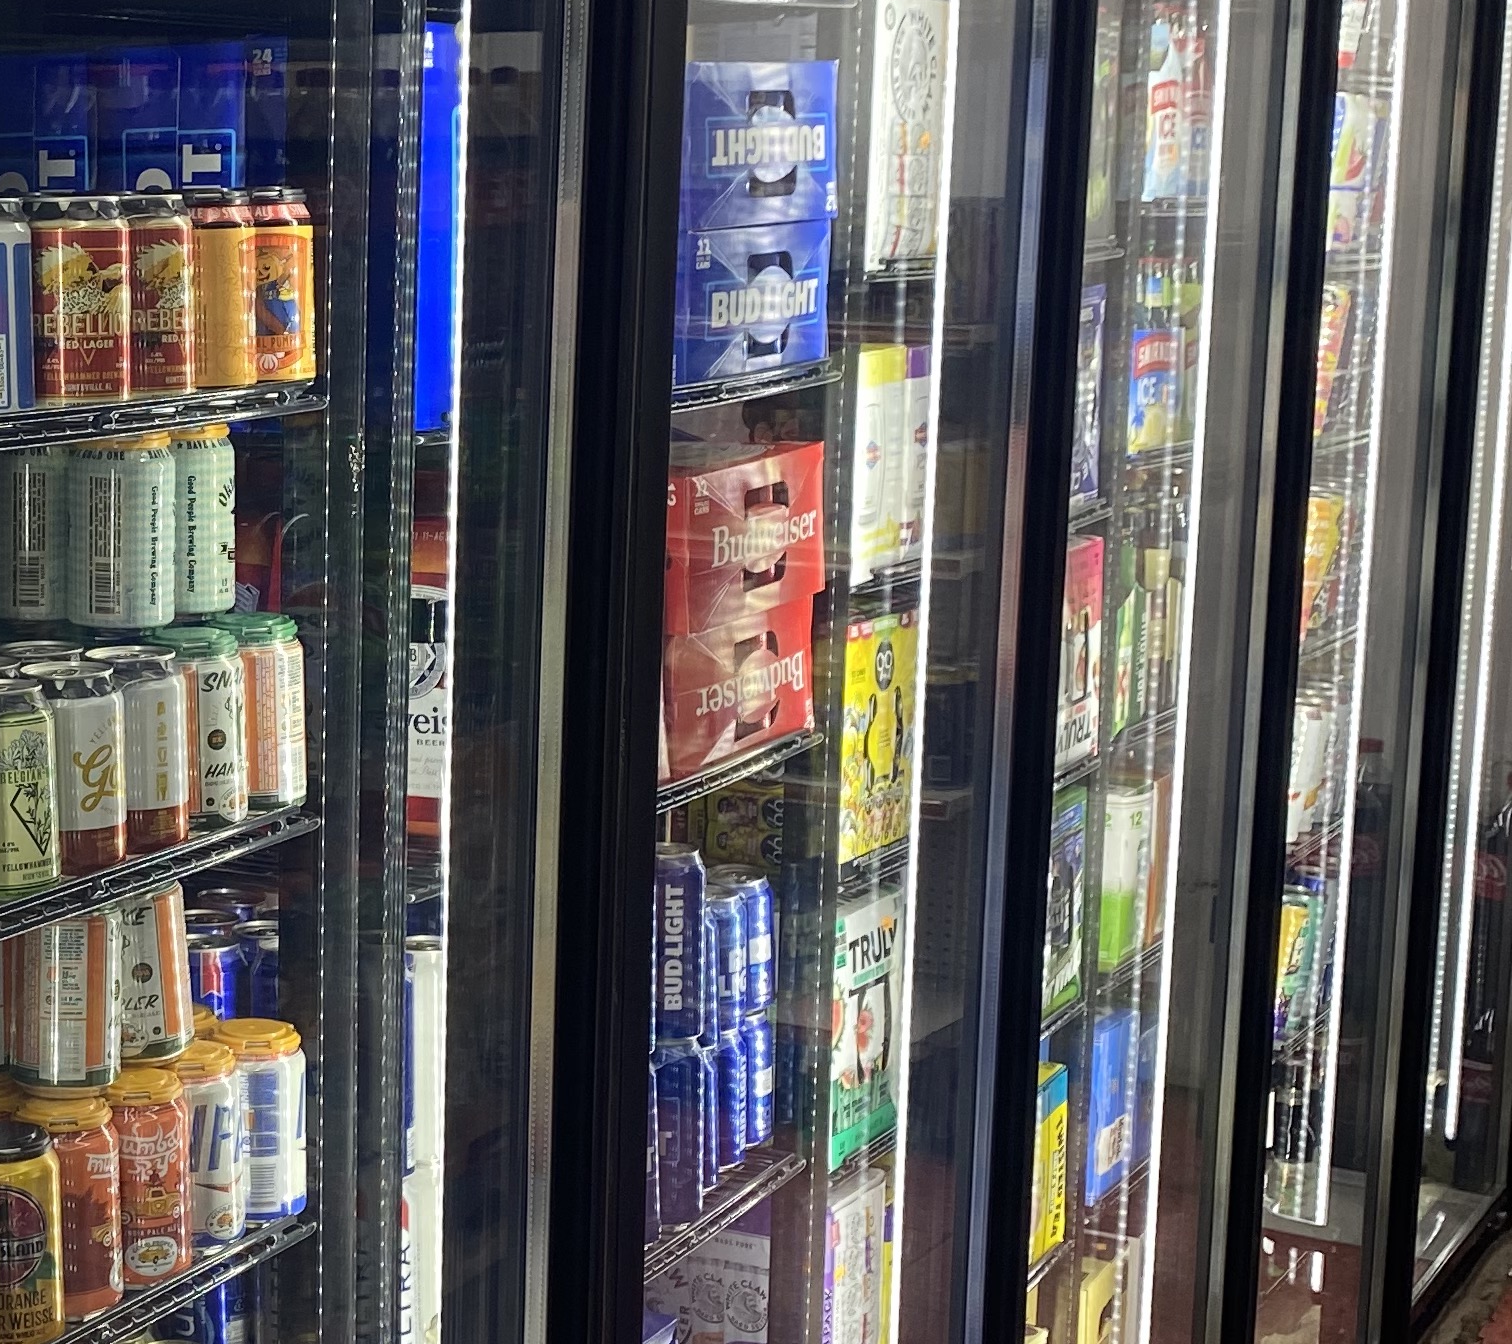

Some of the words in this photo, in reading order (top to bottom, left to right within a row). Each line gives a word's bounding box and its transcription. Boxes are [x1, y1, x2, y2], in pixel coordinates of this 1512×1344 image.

[252, 48, 274, 64] 24
[711, 285, 761, 329] BUD
[84, 339, 114, 349] LAGER
[188, 475, 197, 494] Good
[188, 497, 197, 522] People
[150, 537, 158, 569] Brewing
[187, 524, 197, 557] Brewing
[711, 507, 818, 569] Budweiser
[149, 571, 158, 605] Company
[187, 560, 197, 593] Company
[694, 650, 806, 718] Budweiser
[663, 883, 684, 956] LIGHT
[663, 957, 683, 1012] BUD
[10, 1308, 54, 1330] WEISSE
